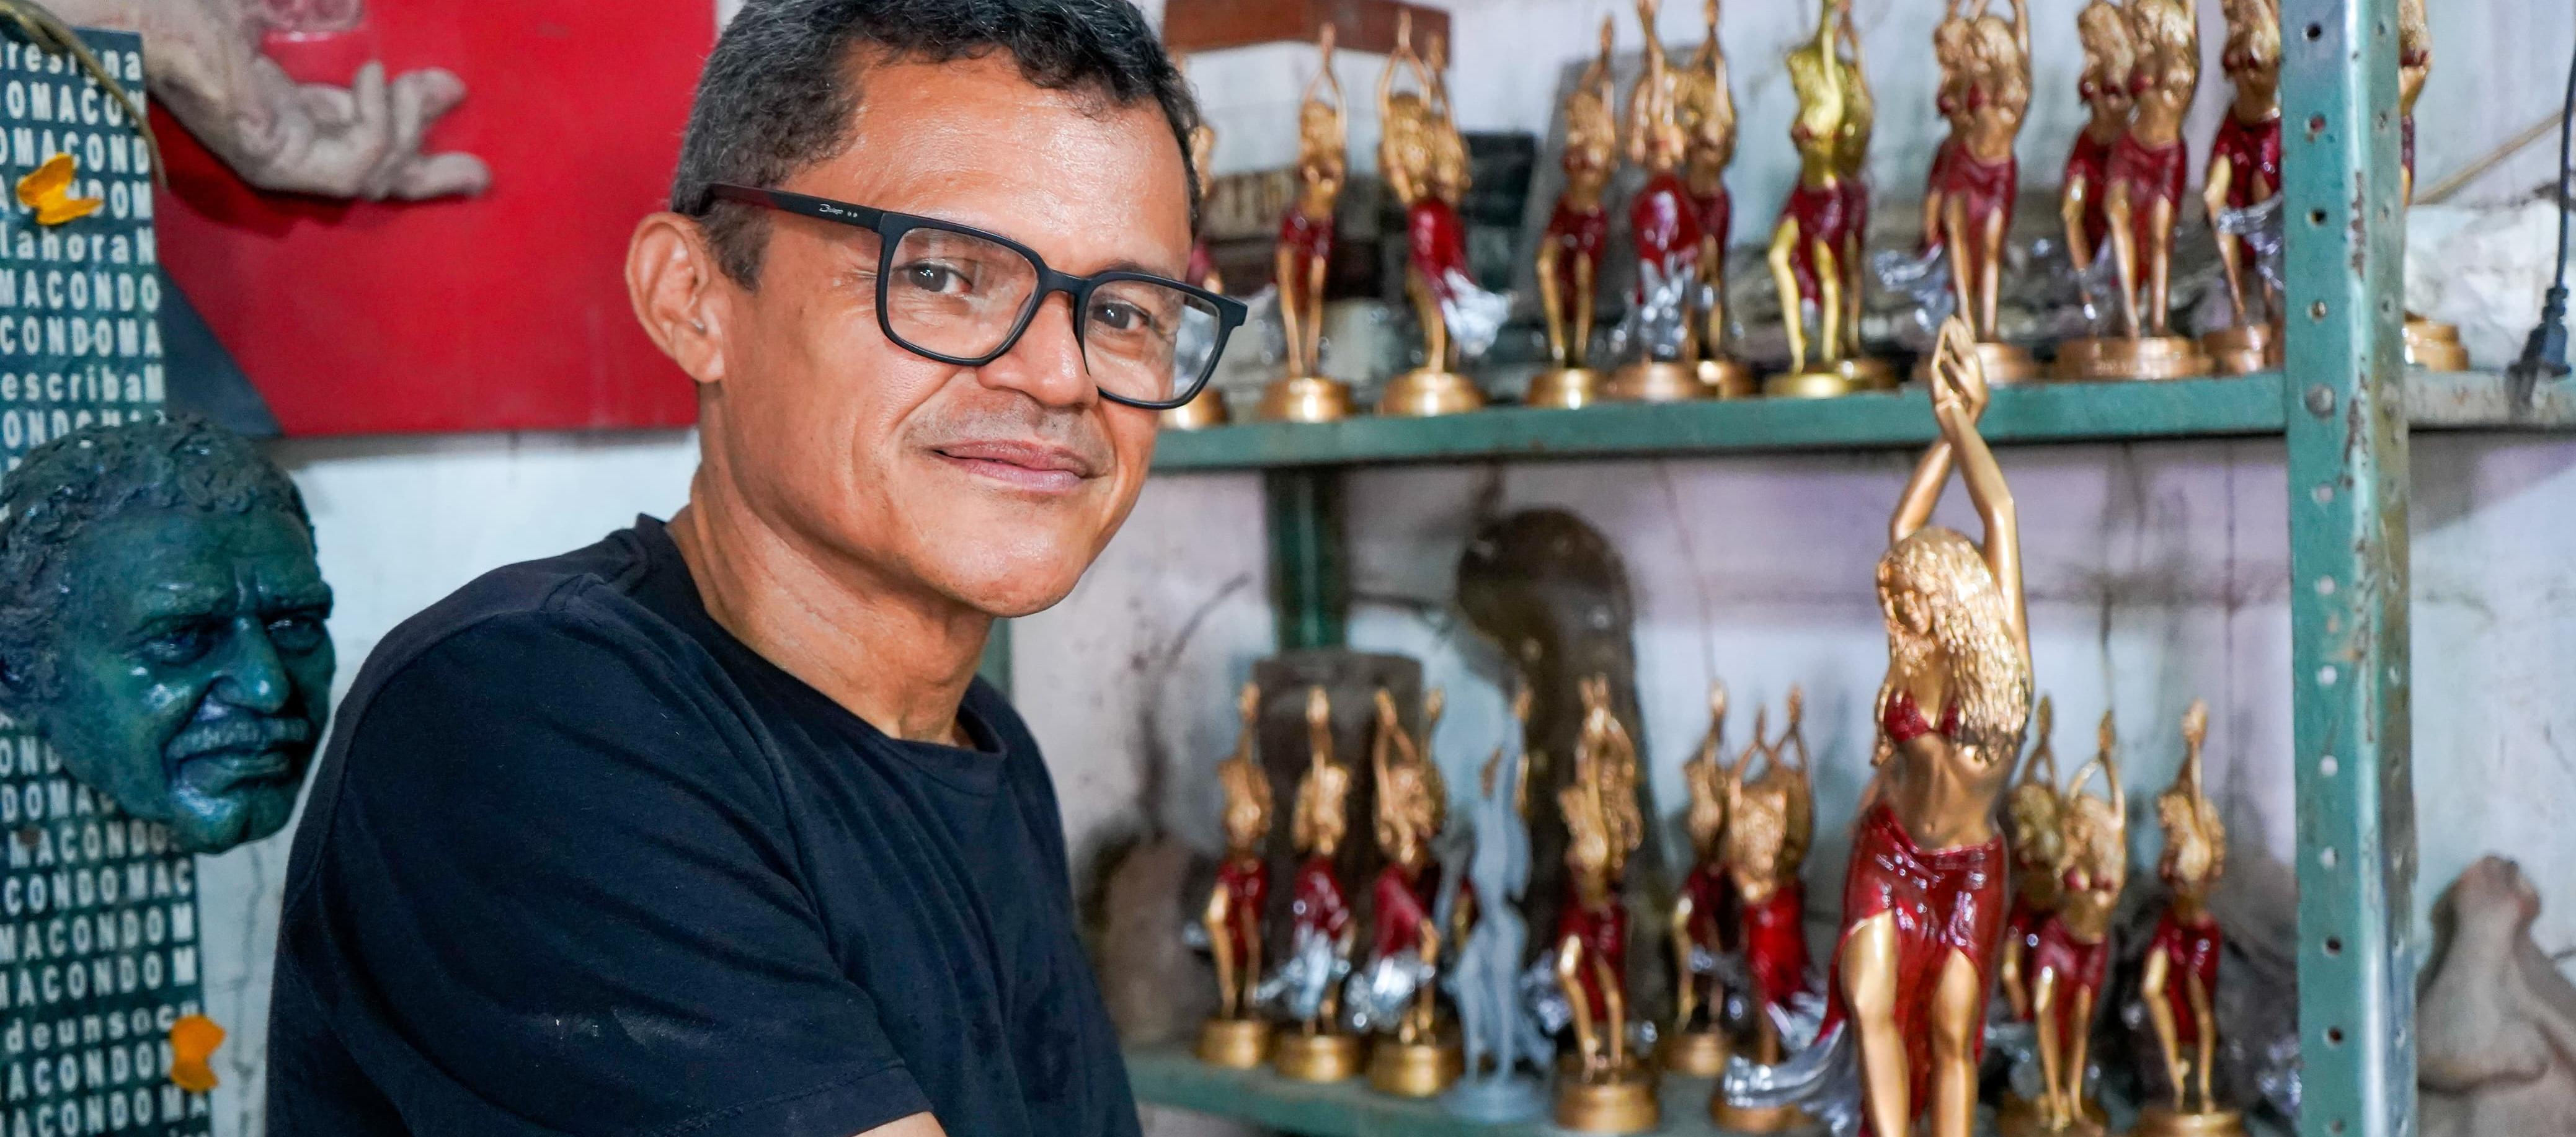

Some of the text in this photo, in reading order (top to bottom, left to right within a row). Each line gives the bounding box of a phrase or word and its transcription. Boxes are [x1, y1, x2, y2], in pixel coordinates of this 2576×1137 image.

[0, 80, 146, 128] OMACON
[0, 268, 161, 314] MACONDO
[0, 315, 165, 358] CONDOMA
[9, 818, 182, 868] MACONDO
[4, 858, 193, 916] CONDOMAC
